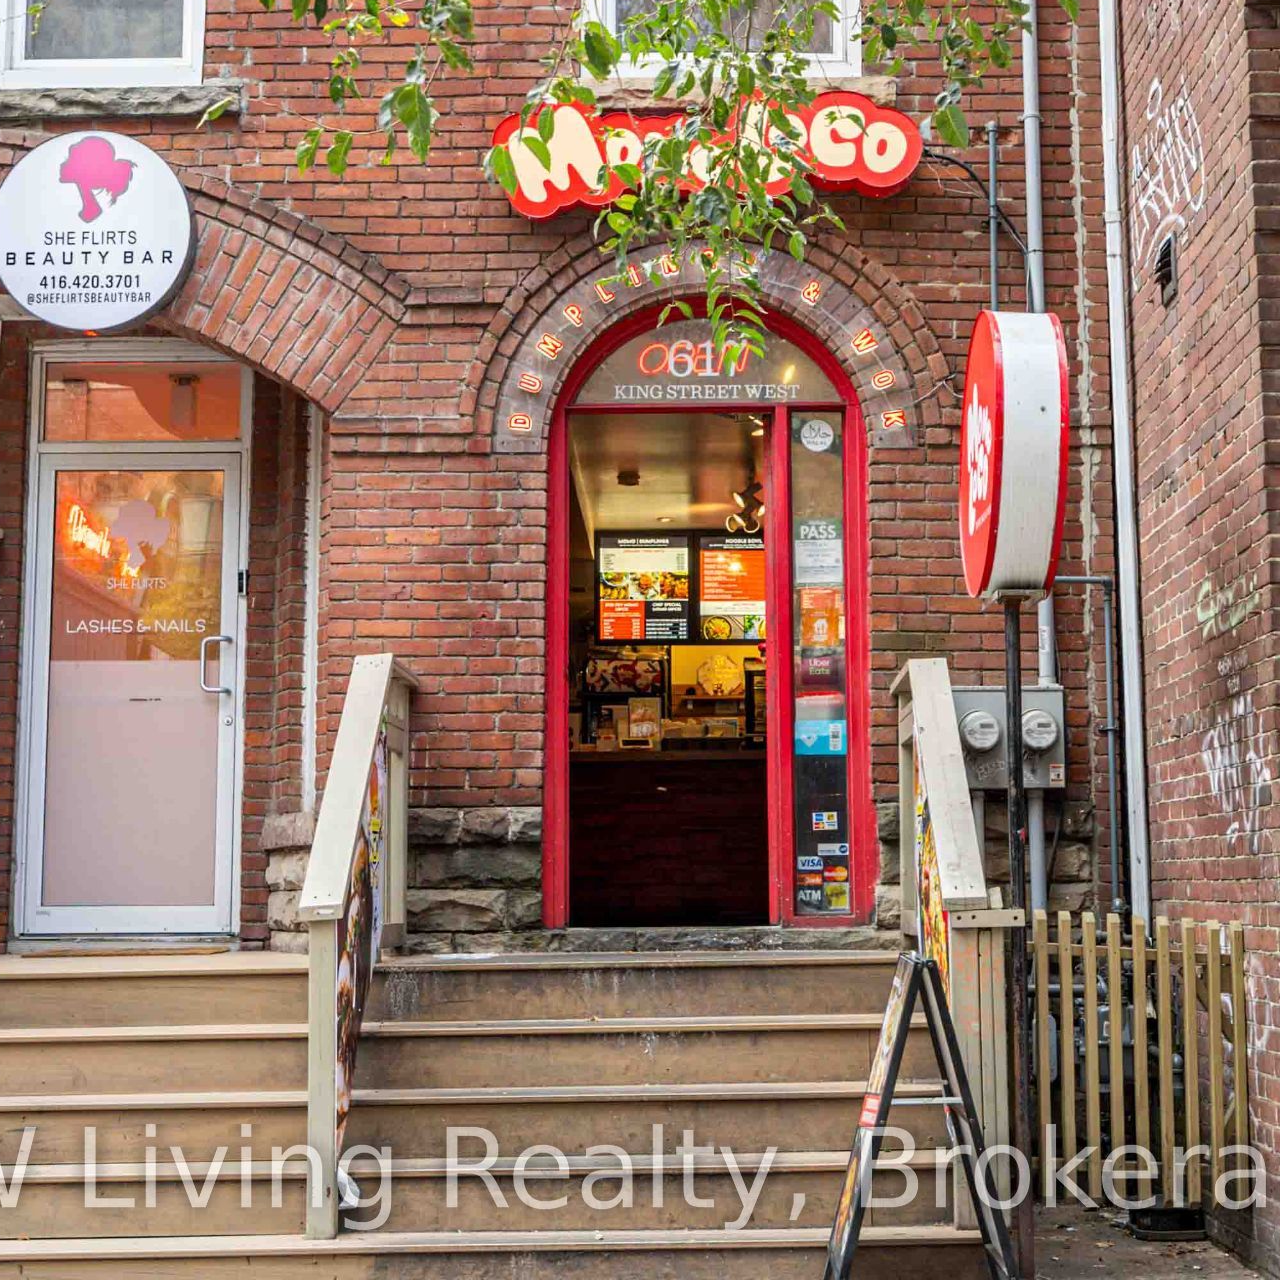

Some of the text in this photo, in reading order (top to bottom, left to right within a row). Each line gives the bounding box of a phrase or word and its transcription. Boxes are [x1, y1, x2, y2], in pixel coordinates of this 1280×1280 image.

[44, 229, 137, 246] SHE FLIRTS
[5, 249, 173, 266] BEAUTY BAR
[39, 273, 140, 289] 416.420.3701
[27, 290, 151, 306] @SHEFLIRTSBEAUTYBAR
[851, 327, 908, 430] WOK
[614, 383, 800, 400] KING STREET WEST
[799, 525, 837, 539] PASS
[66, 620, 206, 633] LASHES & NAILS
[800, 858, 823, 867] VISA
[797, 889, 822, 902] ATM
